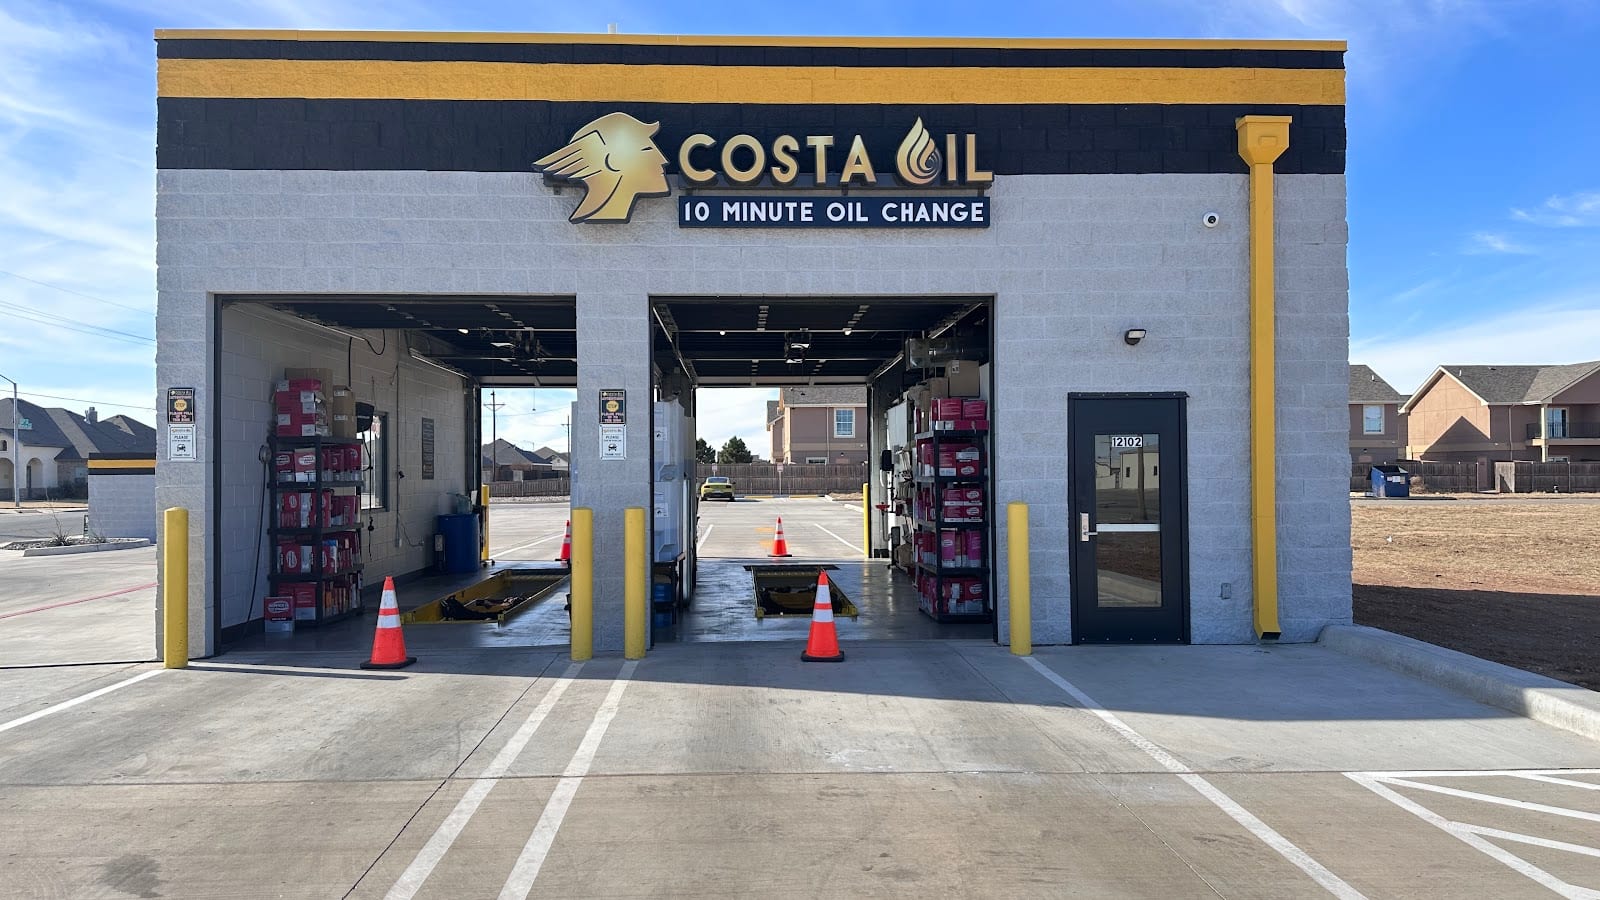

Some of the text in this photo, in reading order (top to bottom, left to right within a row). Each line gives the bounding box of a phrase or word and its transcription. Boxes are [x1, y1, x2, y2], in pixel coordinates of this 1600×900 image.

[678, 133, 877, 185] COSTA
[684, 201, 985, 223] 10 MINUTE OIL CHANGE
[1113, 438, 1142, 446] 12102
